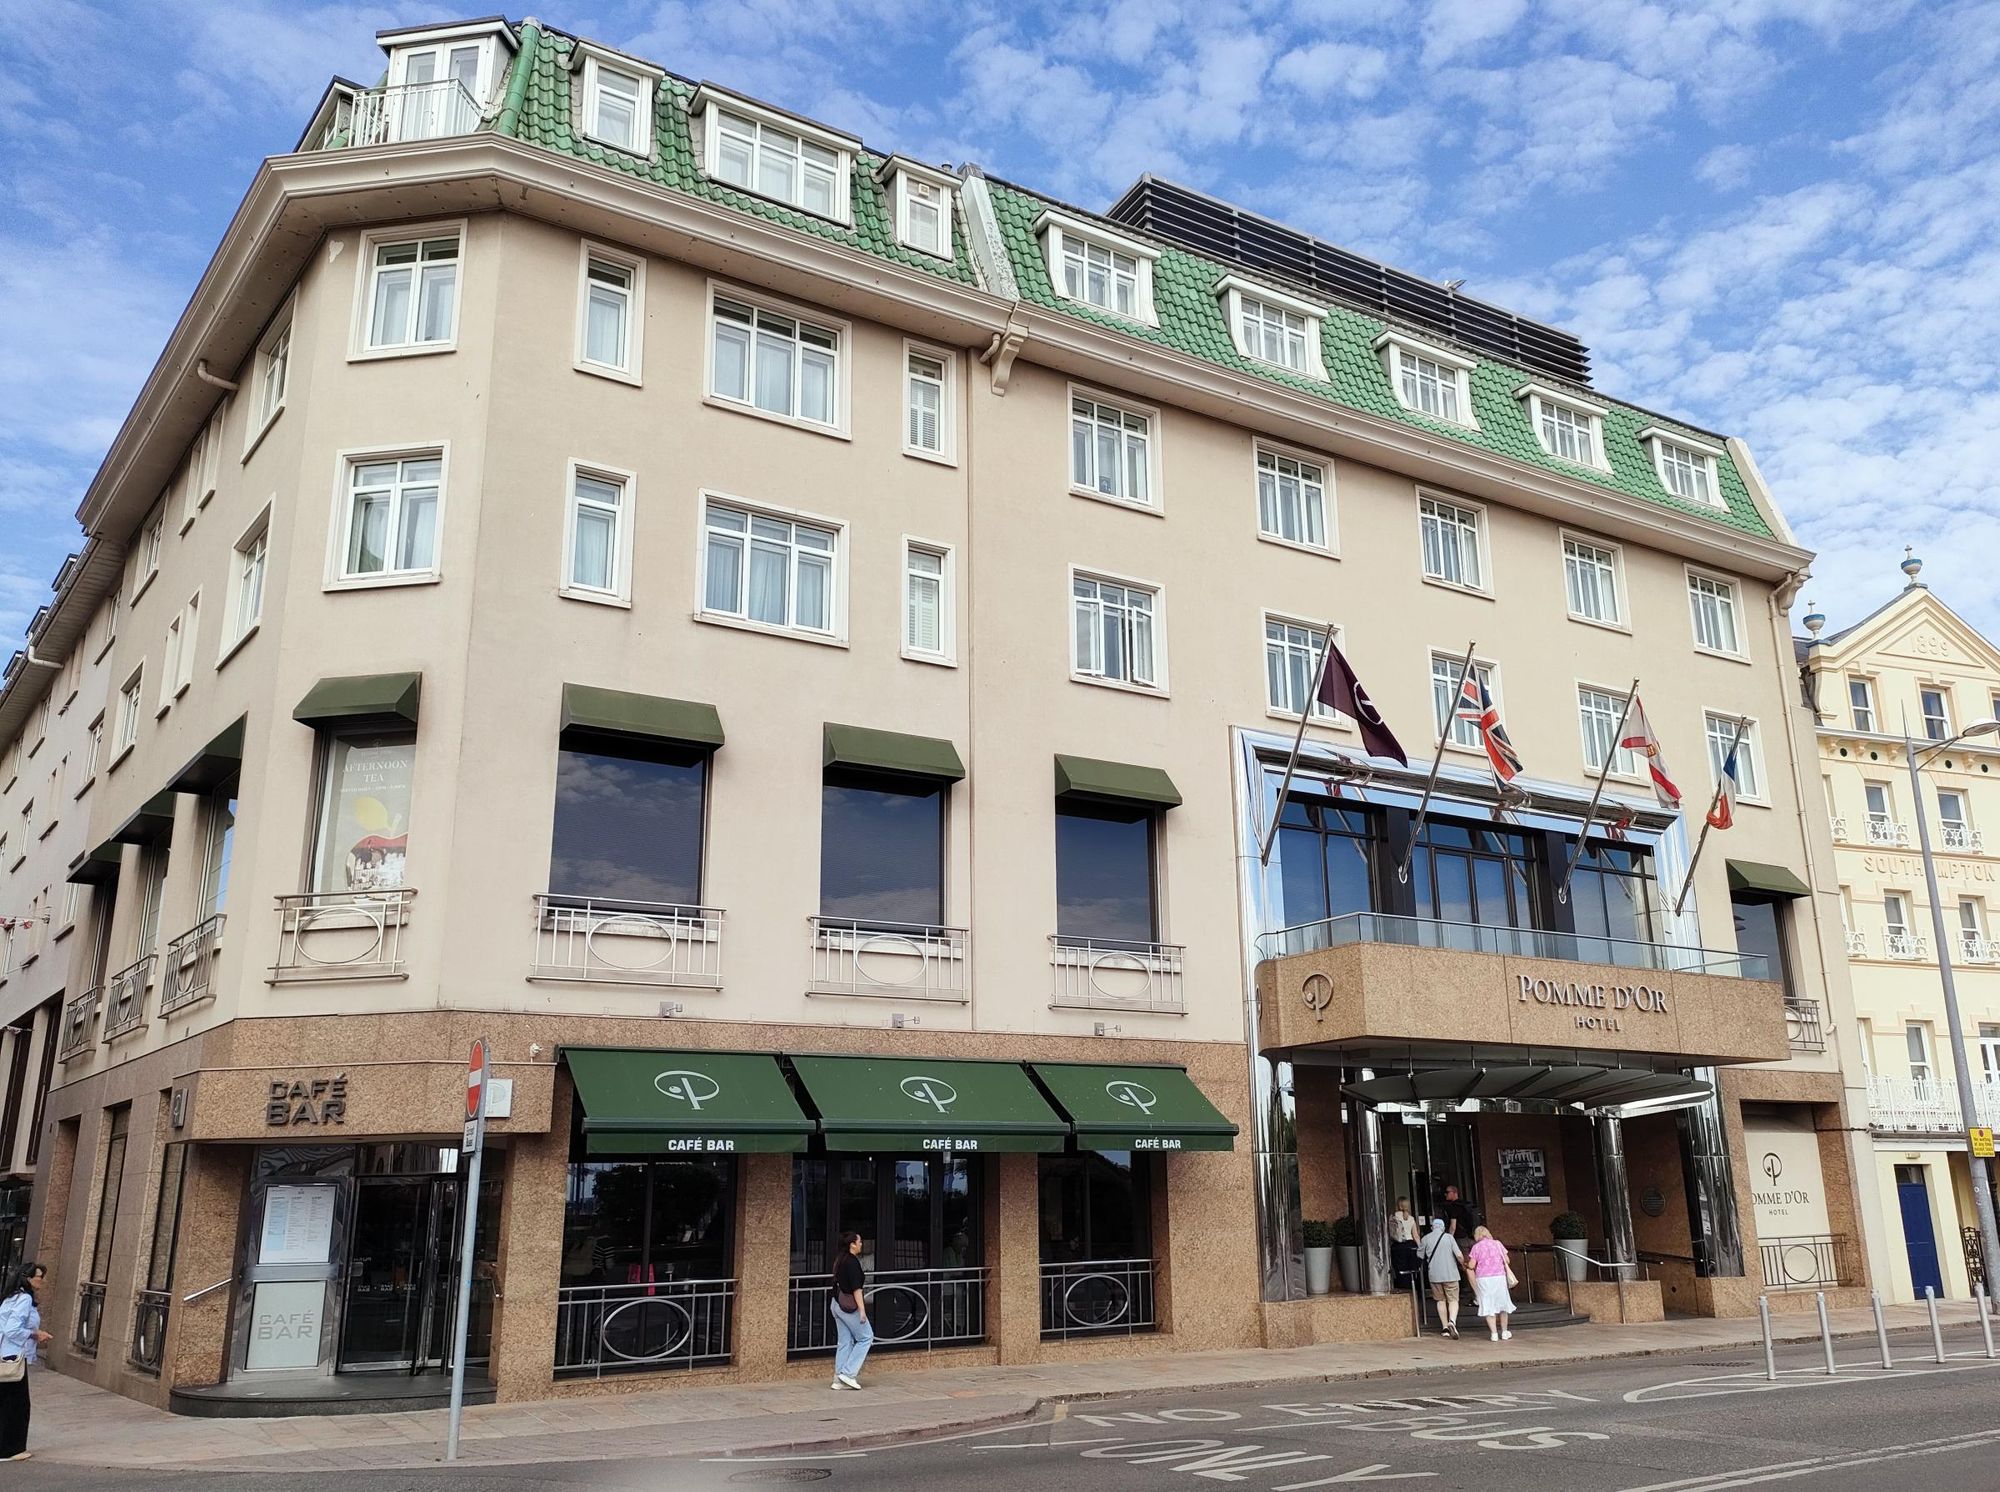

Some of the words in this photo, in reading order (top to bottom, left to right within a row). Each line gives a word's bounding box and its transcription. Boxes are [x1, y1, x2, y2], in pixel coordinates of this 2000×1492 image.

[343, 760, 408, 772] AFTERNOON
[363, 773, 384, 783] TEA
[1863, 855, 1996, 882] SOUTHMPTON
[1517, 974, 1606, 1009] POMME
[1612, 984, 1668, 1013] D'OR
[1574, 1016, 1621, 1032] HOTEL
[268, 1073, 349, 1100] CAFÉ
[265, 1100, 346, 1126] BAR
[668, 1136, 703, 1151] CAFÉ
[706, 1139, 735, 1151] BAR
[922, 1136, 952, 1150] CAFÉ
[955, 1139, 978, 1150] BAR
[1135, 1136, 1160, 1149] CAFÉ
[1162, 1139, 1182, 1149] BAR
[1751, 1192, 1783, 1205] OMME
[1784, 1190, 1810, 1205] D'OR
[1768, 1208, 1789, 1216] HOTEL
[259, 1310, 314, 1325] CAFÉ
[257, 1325, 313, 1340] BAR
[1074, 1408, 1243, 1427] NO
[1336, 1416, 1611, 1450] BUS
[1079, 1439, 1441, 1491] ONLY
